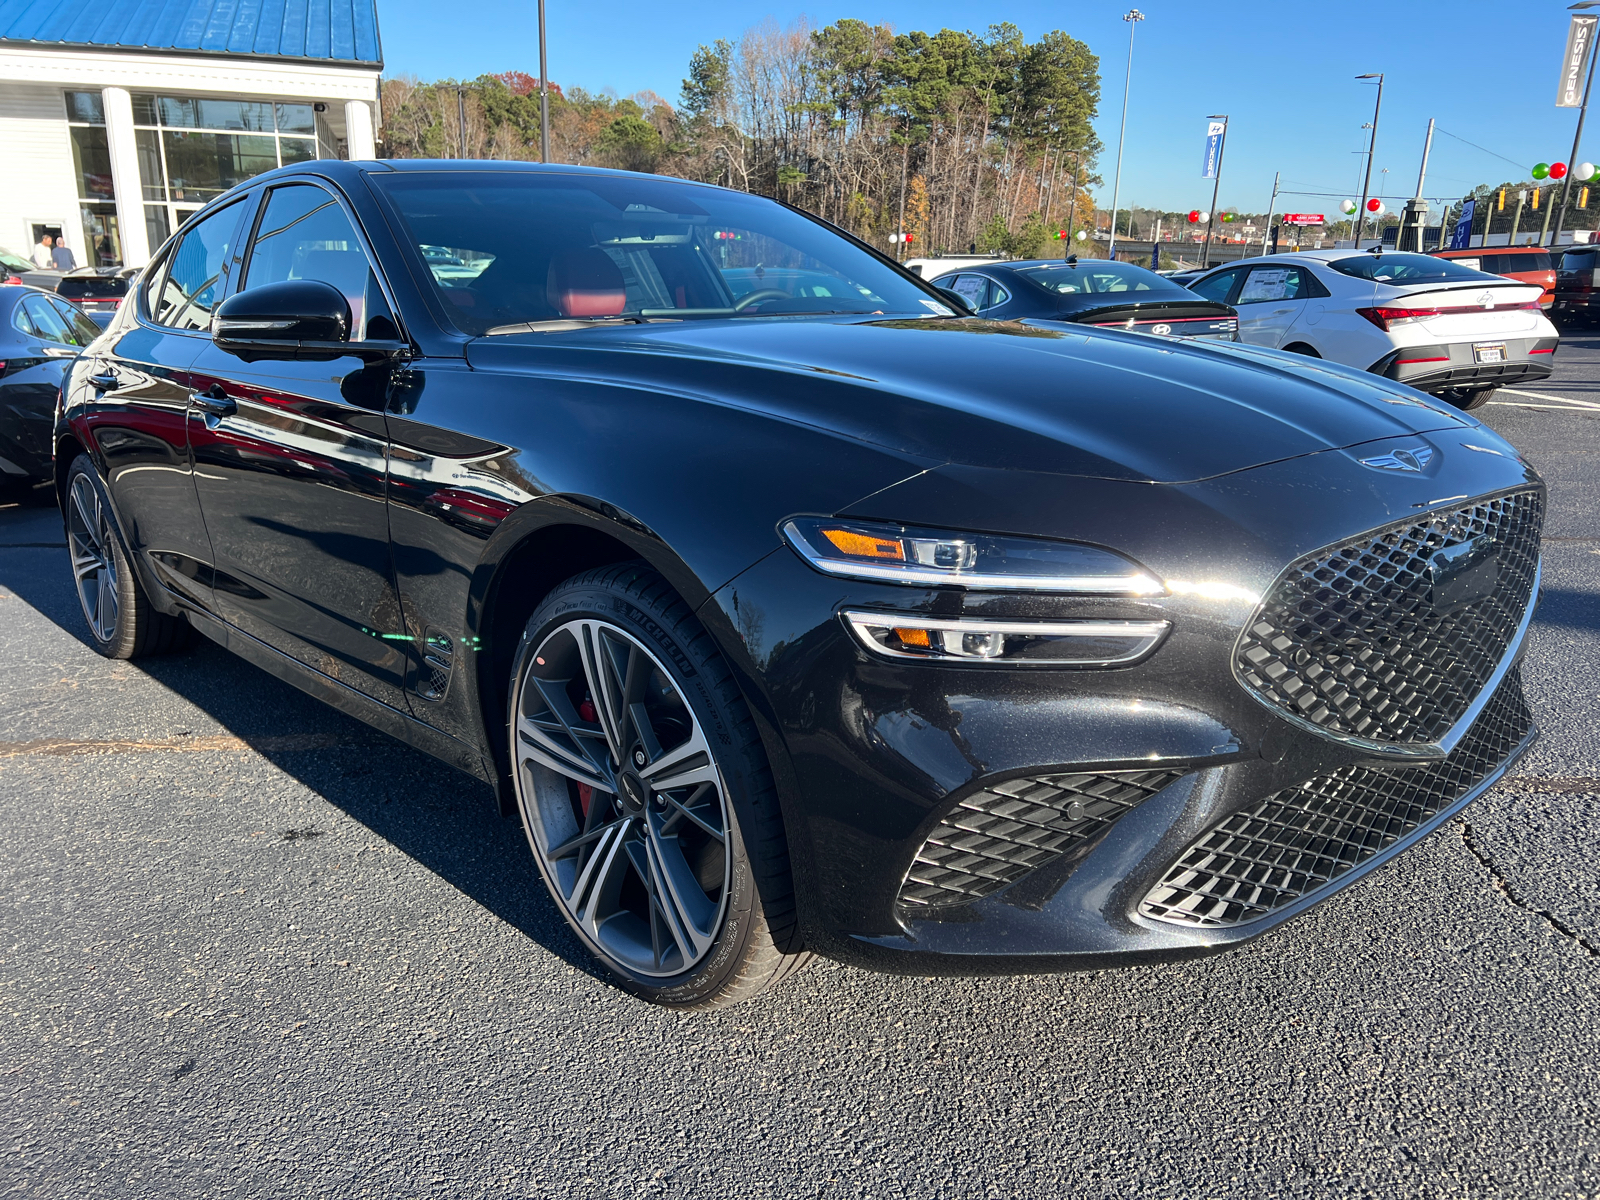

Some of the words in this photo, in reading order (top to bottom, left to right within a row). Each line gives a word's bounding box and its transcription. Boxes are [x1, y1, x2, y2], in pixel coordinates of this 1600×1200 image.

[1564, 26, 1588, 104] GENESIS
[1207, 135, 1218, 178] HYUNDAI
[629, 608, 694, 674] MICHELIN
[695, 681, 714, 709] 225/40
